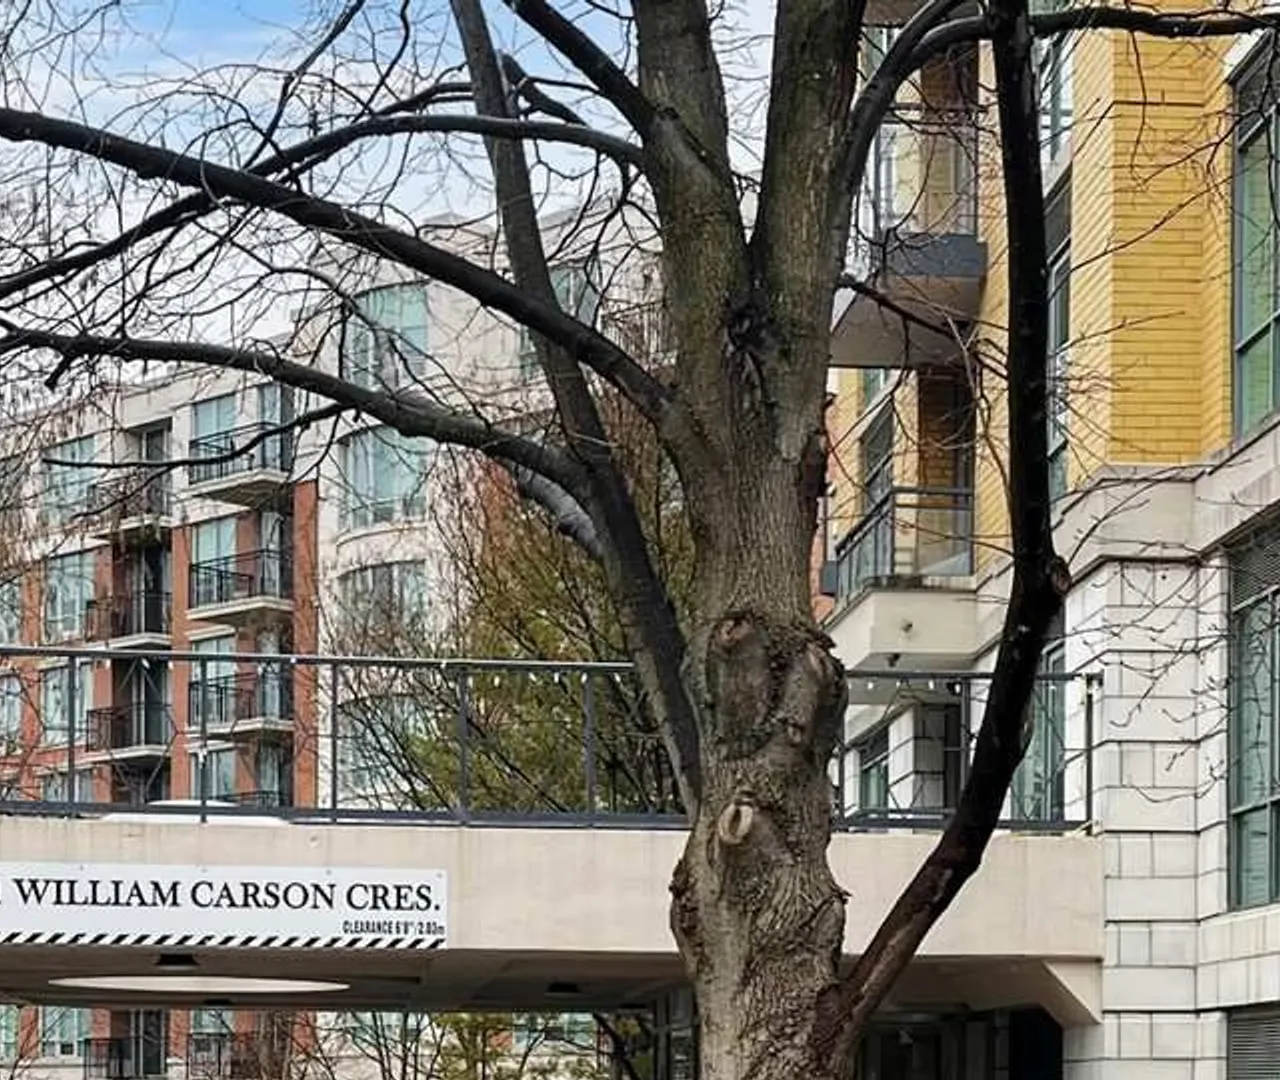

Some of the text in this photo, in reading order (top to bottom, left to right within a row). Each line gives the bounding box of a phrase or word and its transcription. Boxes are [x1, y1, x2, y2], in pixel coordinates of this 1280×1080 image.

[11, 878, 181, 907] WILLIAM
[191, 880, 336, 909] CARSON
[346, 884, 442, 912] CRES.
[342, 920, 393, 934] CLEARANCE
